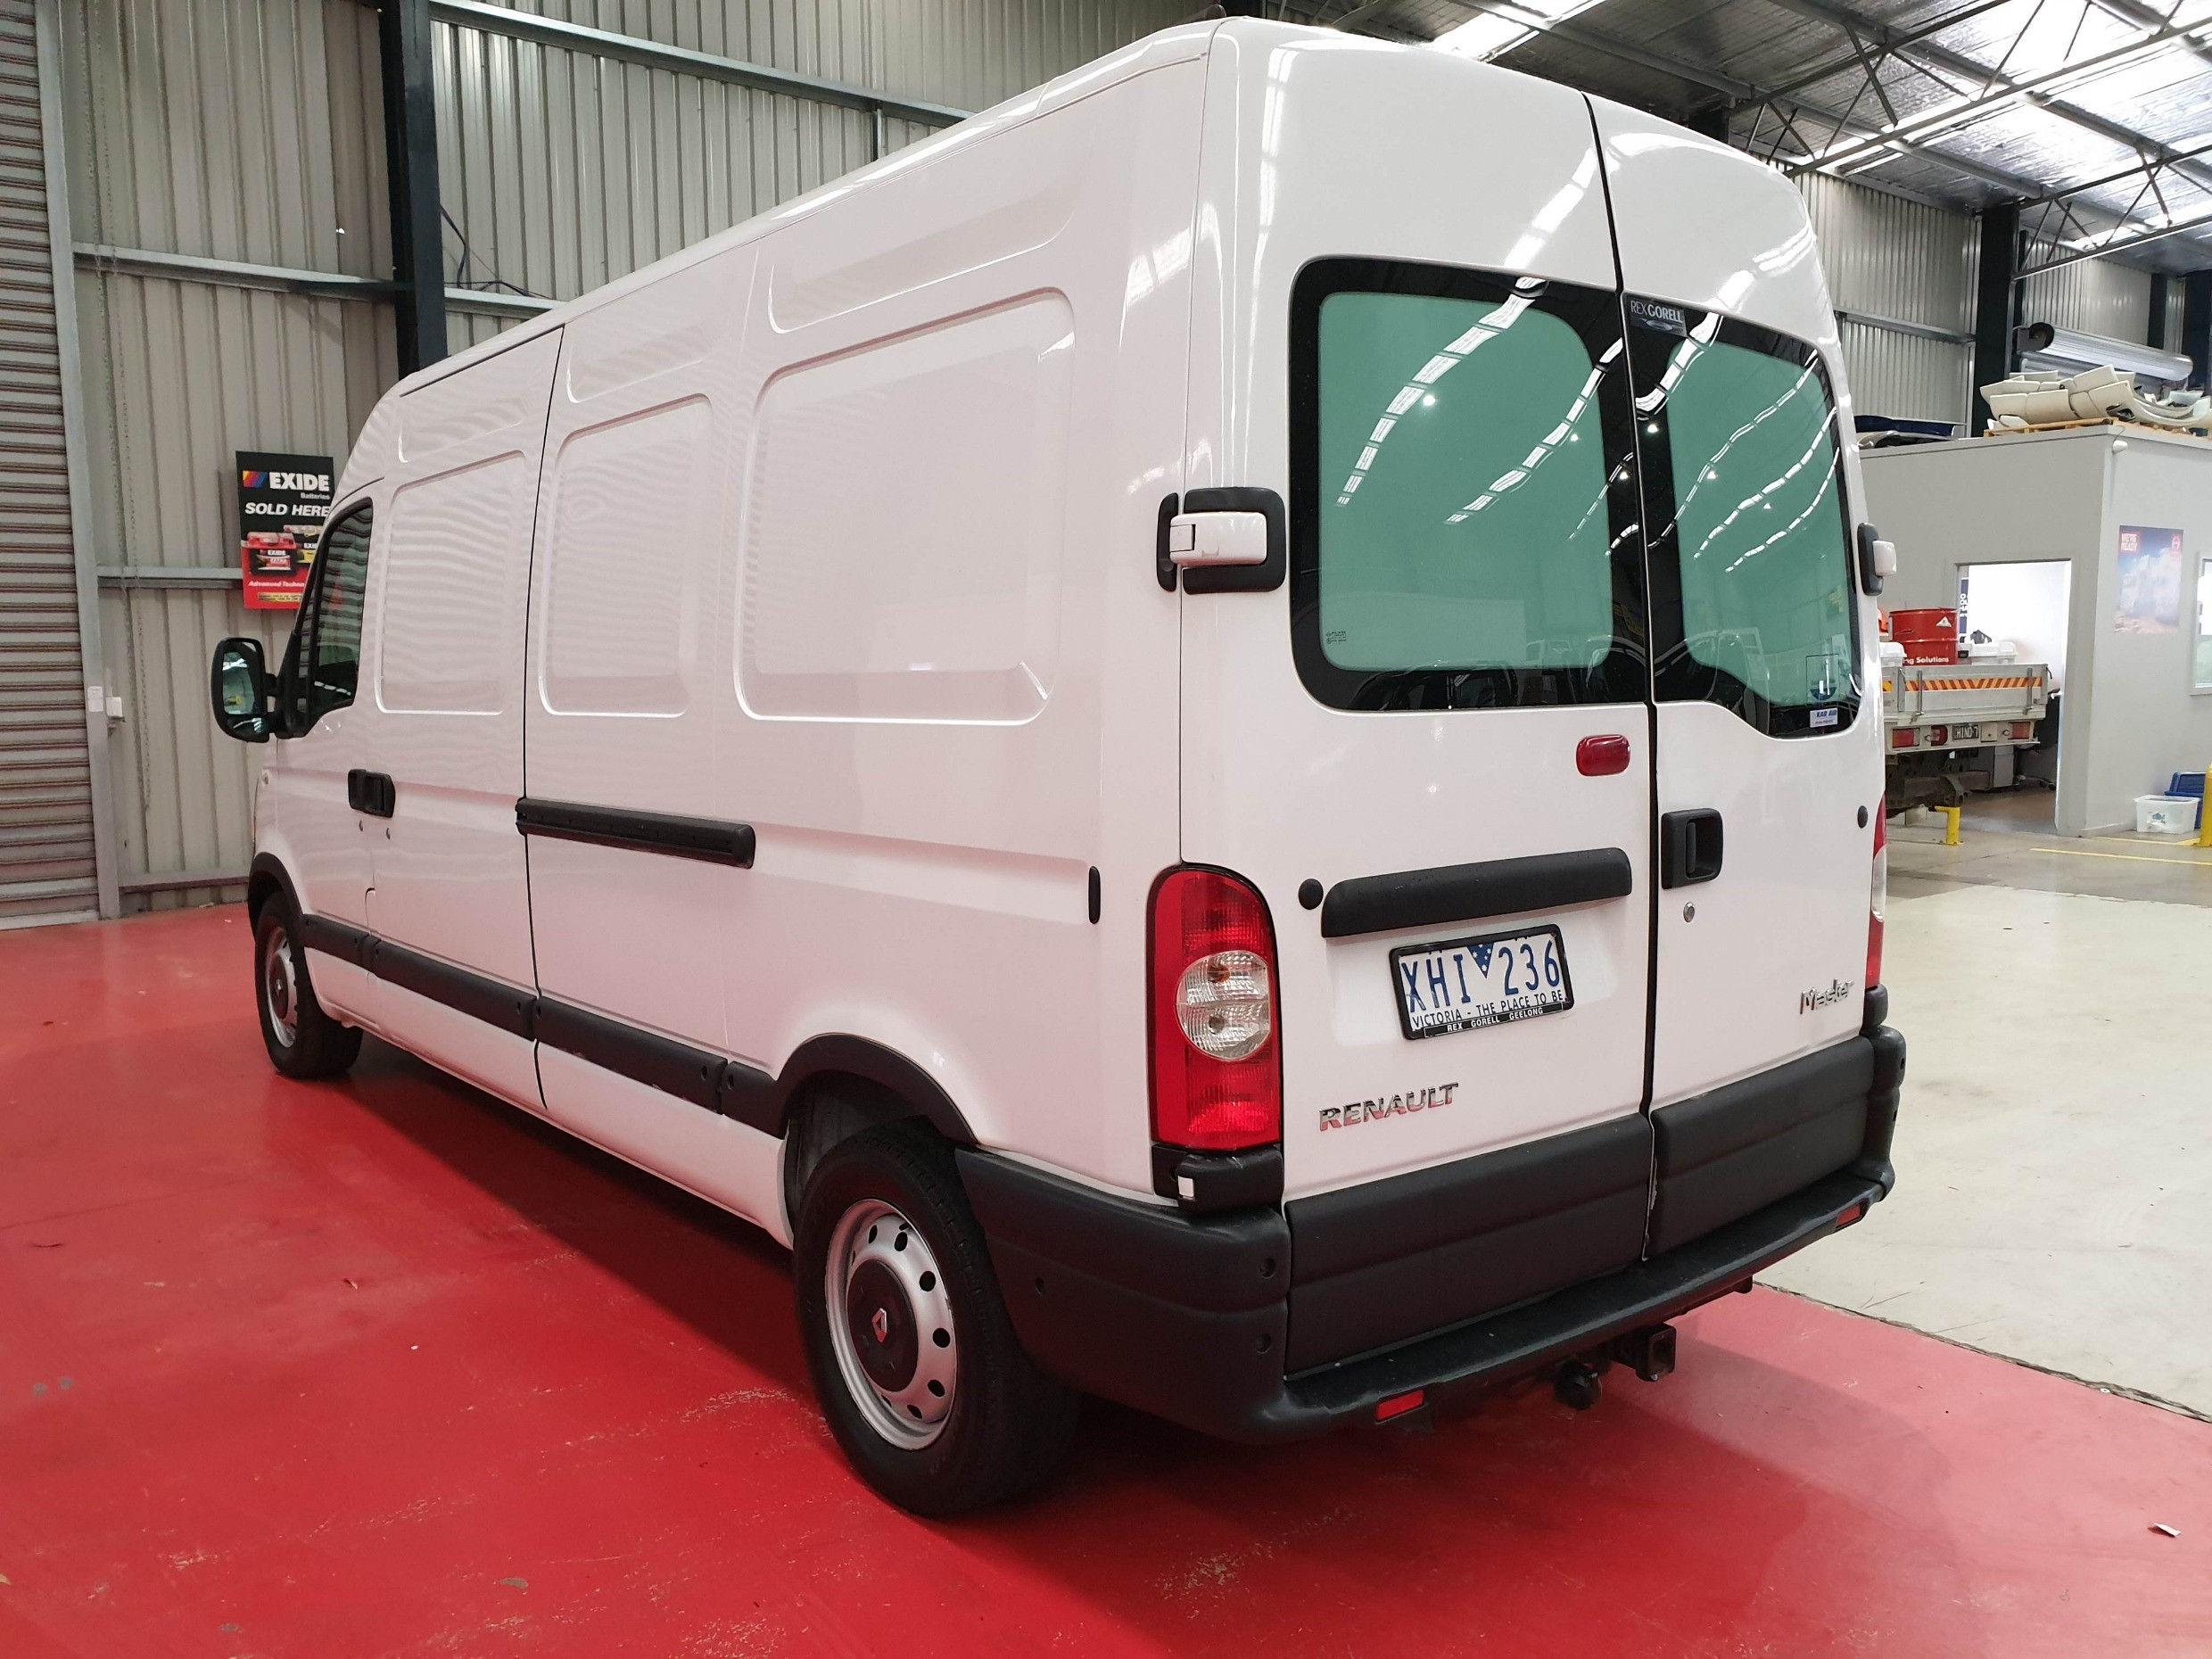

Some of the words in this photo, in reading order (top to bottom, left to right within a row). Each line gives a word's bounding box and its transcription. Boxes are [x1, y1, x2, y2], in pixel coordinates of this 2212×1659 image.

[268, 471, 330, 491] EXIDE
[300, 492, 330, 500] Batteries
[244, 502, 288, 516] SOLD
[291, 504, 330, 517] HERE
[1916, 656, 1950, 664] Solutions
[1400, 953, 1472, 1013] XHI
[1498, 939, 1561, 997] 236
[1412, 1008, 1463, 1028] VICTORIA
[1475, 1001, 1497, 1017] THE
[1500, 995, 1531, 1013] PLACE
[1533, 992, 1548, 1005] TO
[1551, 989, 1564, 1003] BE
[1447, 1020, 1464, 1032] REX
[1470, 1015, 1501, 1028] GORELL
[1508, 1006, 1544, 1021] GEELONG
[1318, 1081, 1460, 1132] RENAULT
